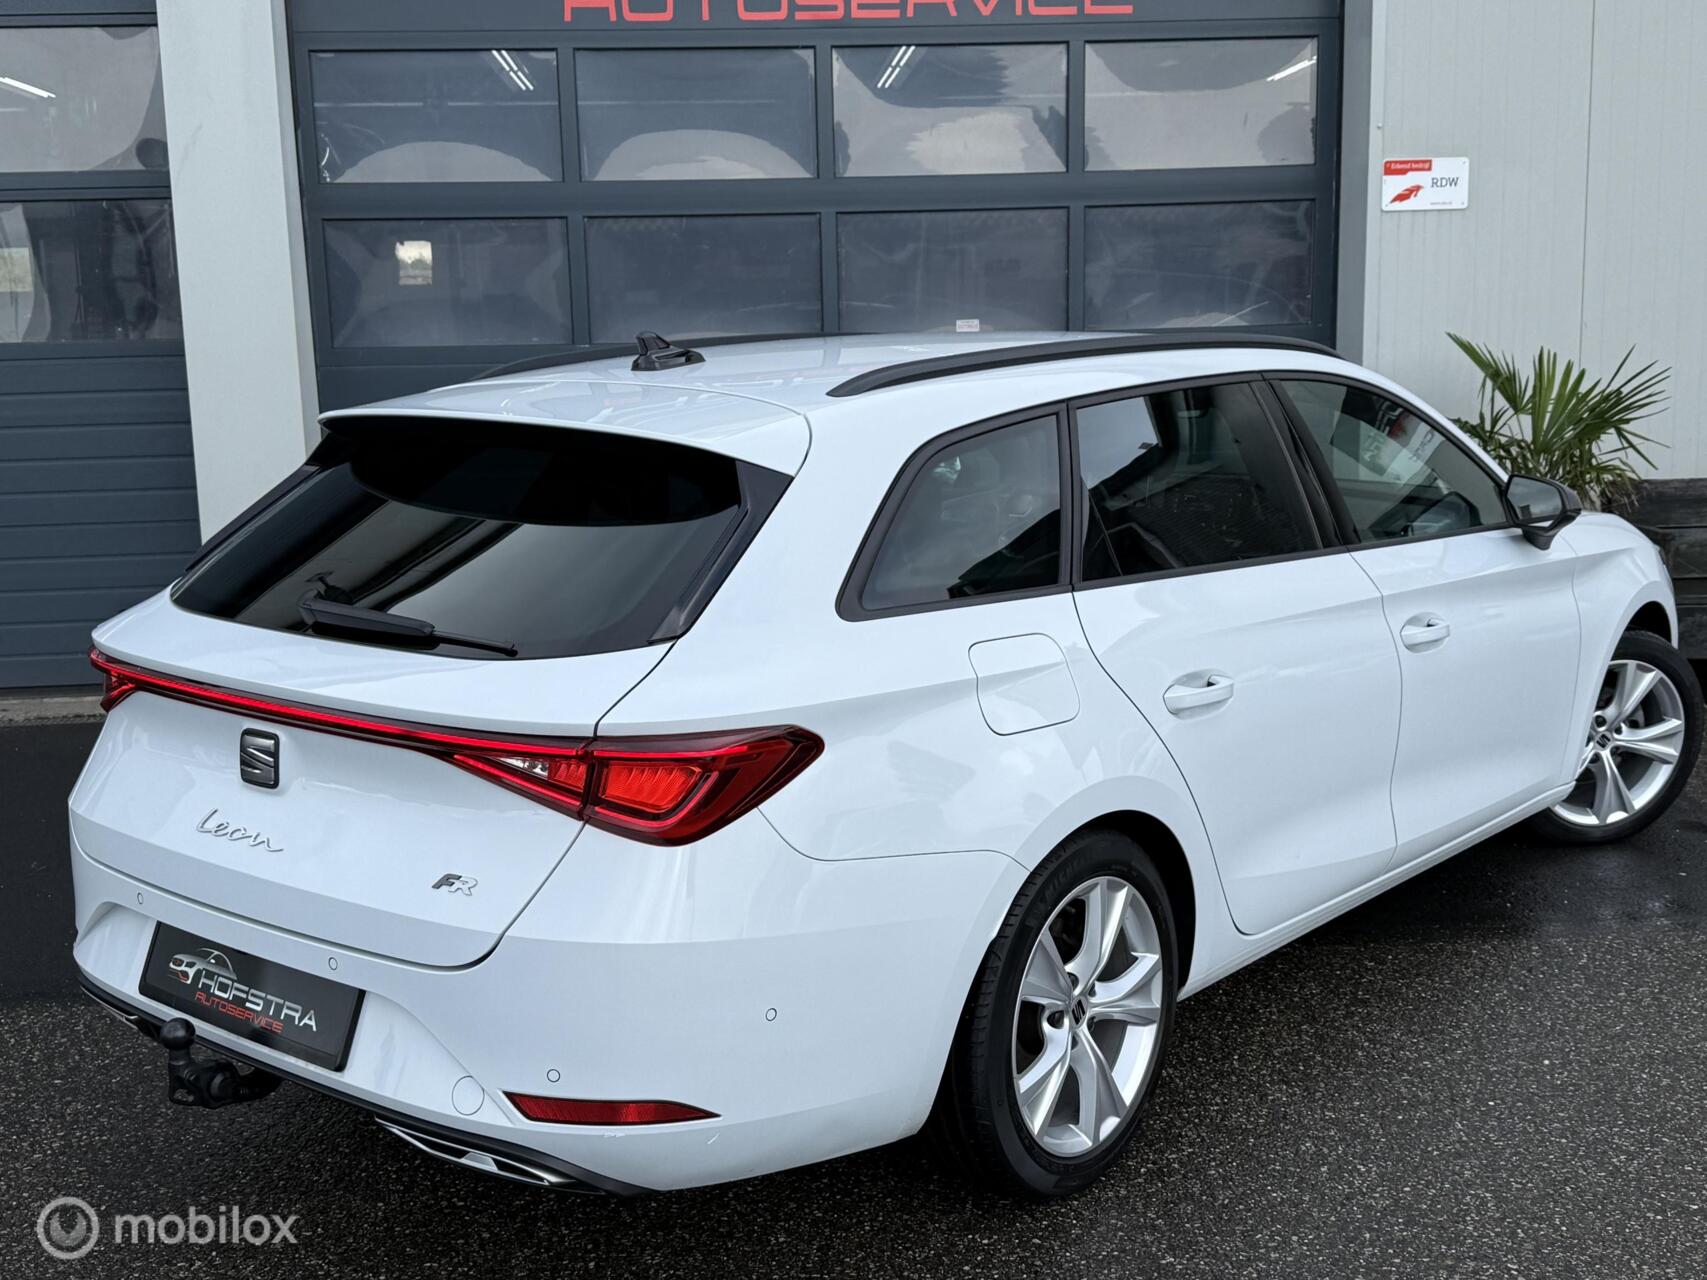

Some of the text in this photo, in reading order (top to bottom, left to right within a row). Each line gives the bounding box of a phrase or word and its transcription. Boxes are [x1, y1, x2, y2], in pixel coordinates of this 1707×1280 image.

[1430, 176, 1459, 188] RDW
[196, 808, 284, 852] Leon
[431, 873, 479, 896] FR
[194, 991, 285, 1034] AUTOSERVICE
[198, 969, 317, 1032] HOFSTRA
